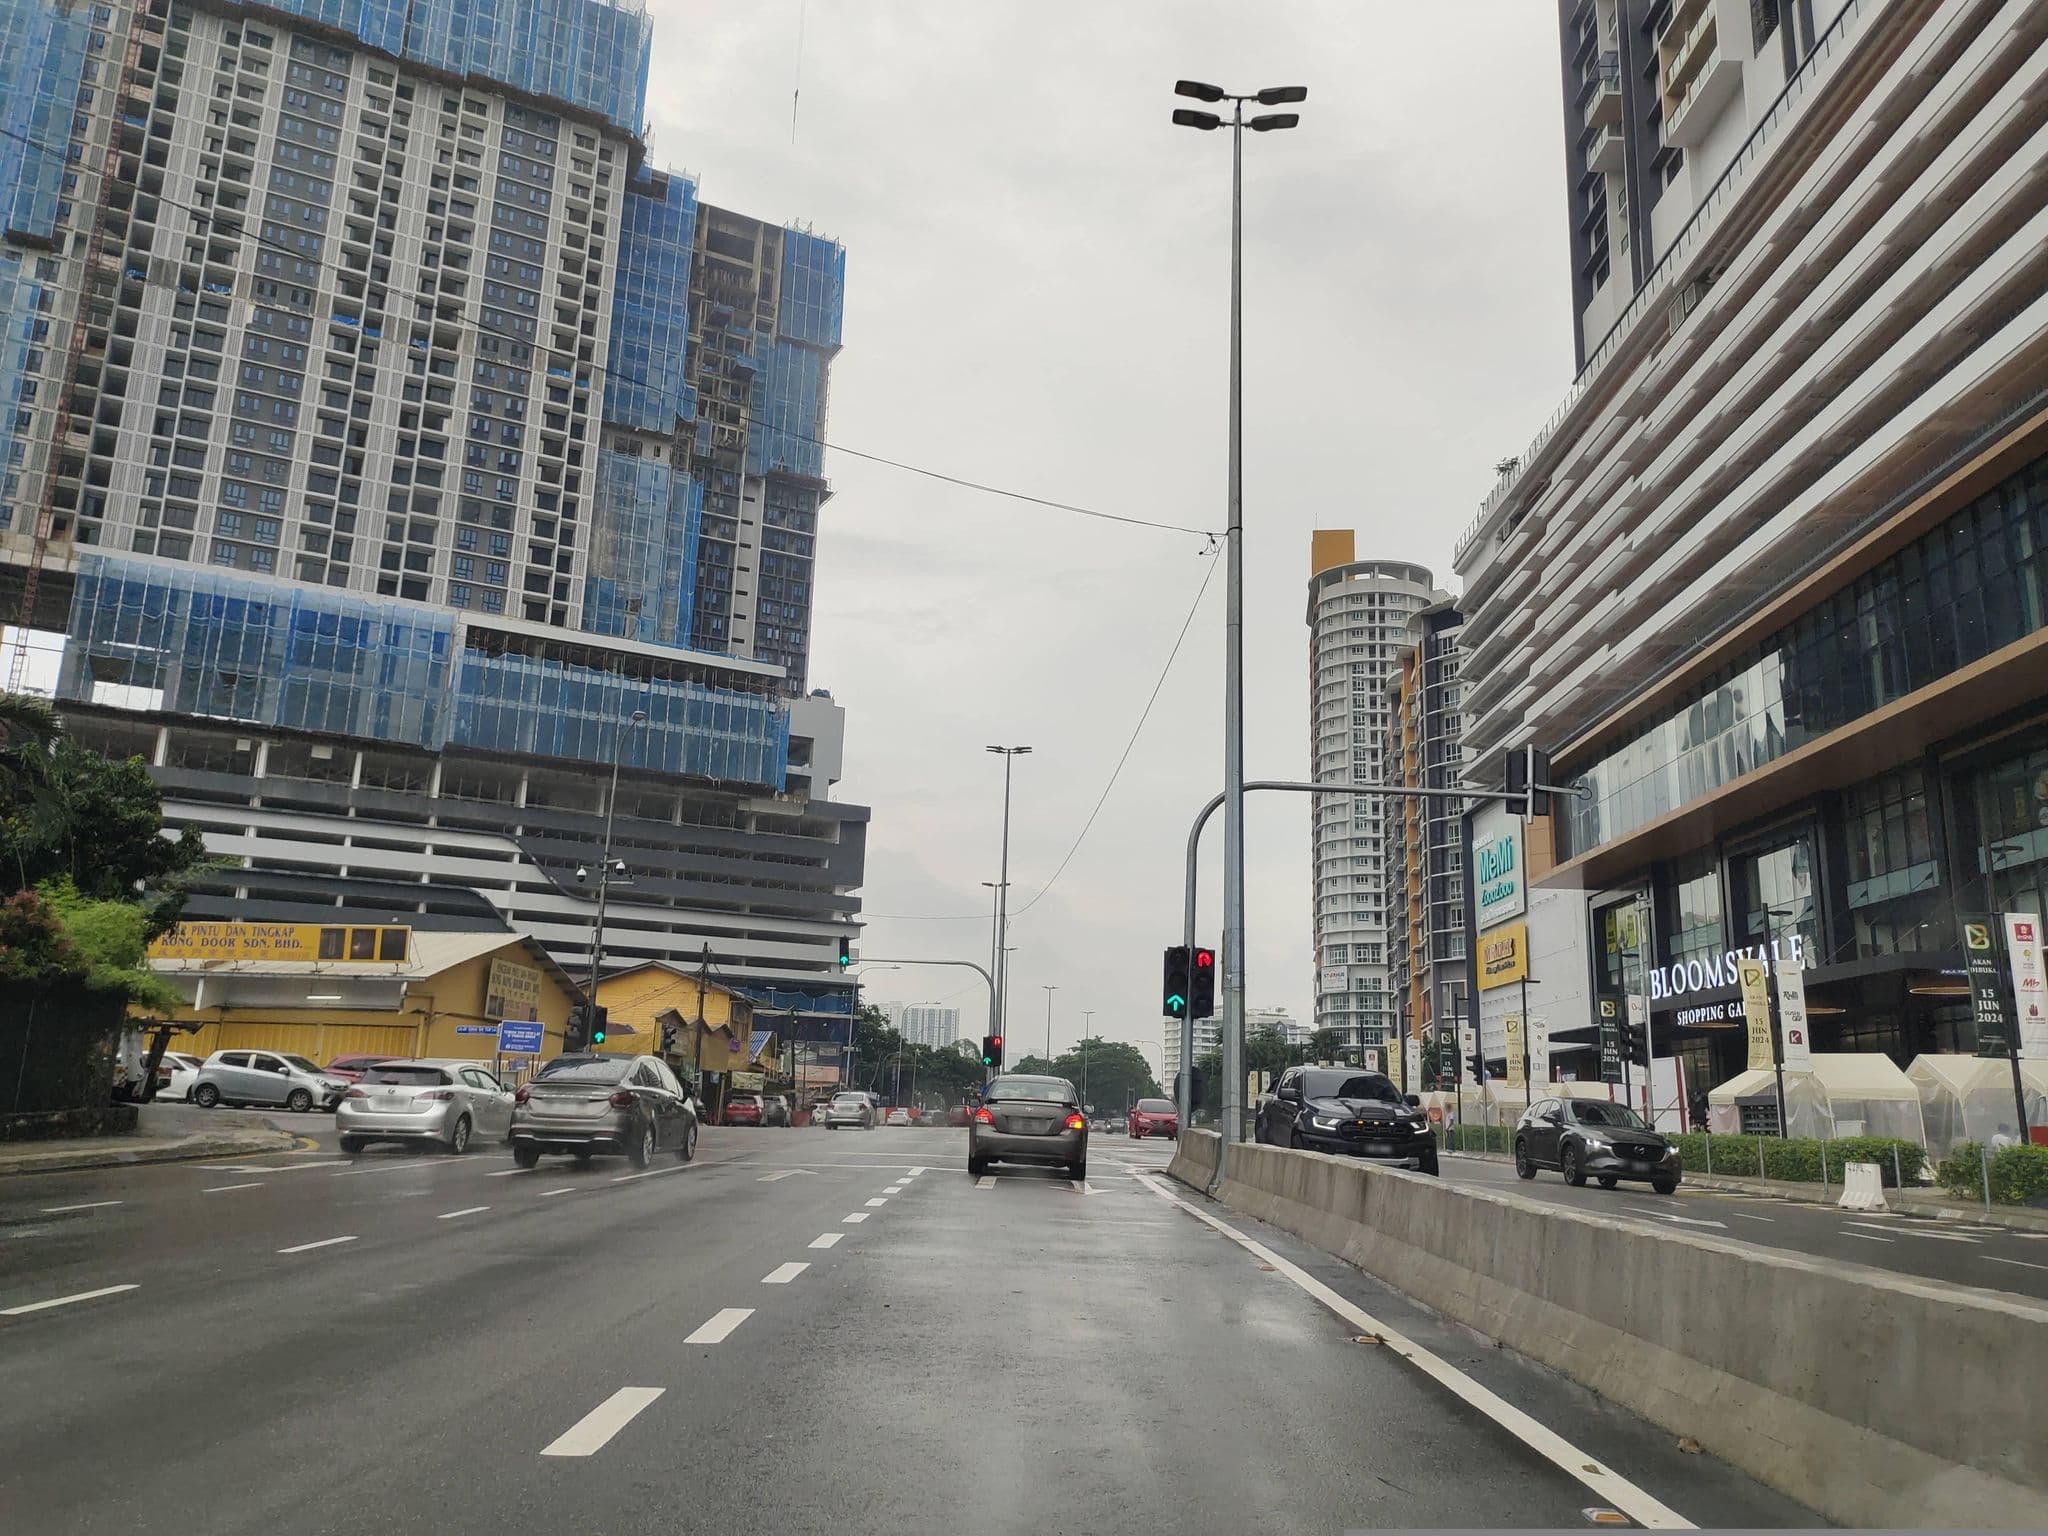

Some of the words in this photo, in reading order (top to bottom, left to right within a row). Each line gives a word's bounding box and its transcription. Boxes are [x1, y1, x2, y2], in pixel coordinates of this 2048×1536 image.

[1480, 834, 1513, 884] MeMi
[191, 926, 221, 936] PINTU
[225, 926, 246, 937] DAN
[252, 927, 295, 938] TINGKAP
[161, 937, 193, 947] KONG
[201, 938, 235, 947] DOOR
[243, 938, 270, 948] SDN.
[274, 939, 303, 949] BHD.
[1981, 989, 1994, 998] 15
[1978, 1001, 2000, 1011] JUN
[1677, 1004, 1724, 1026] SHOPPING
[1977, 1013, 2003, 1023] 2024
[1751, 1027, 1767, 1035] JUN
[1751, 1036, 1769, 1044] 2024
